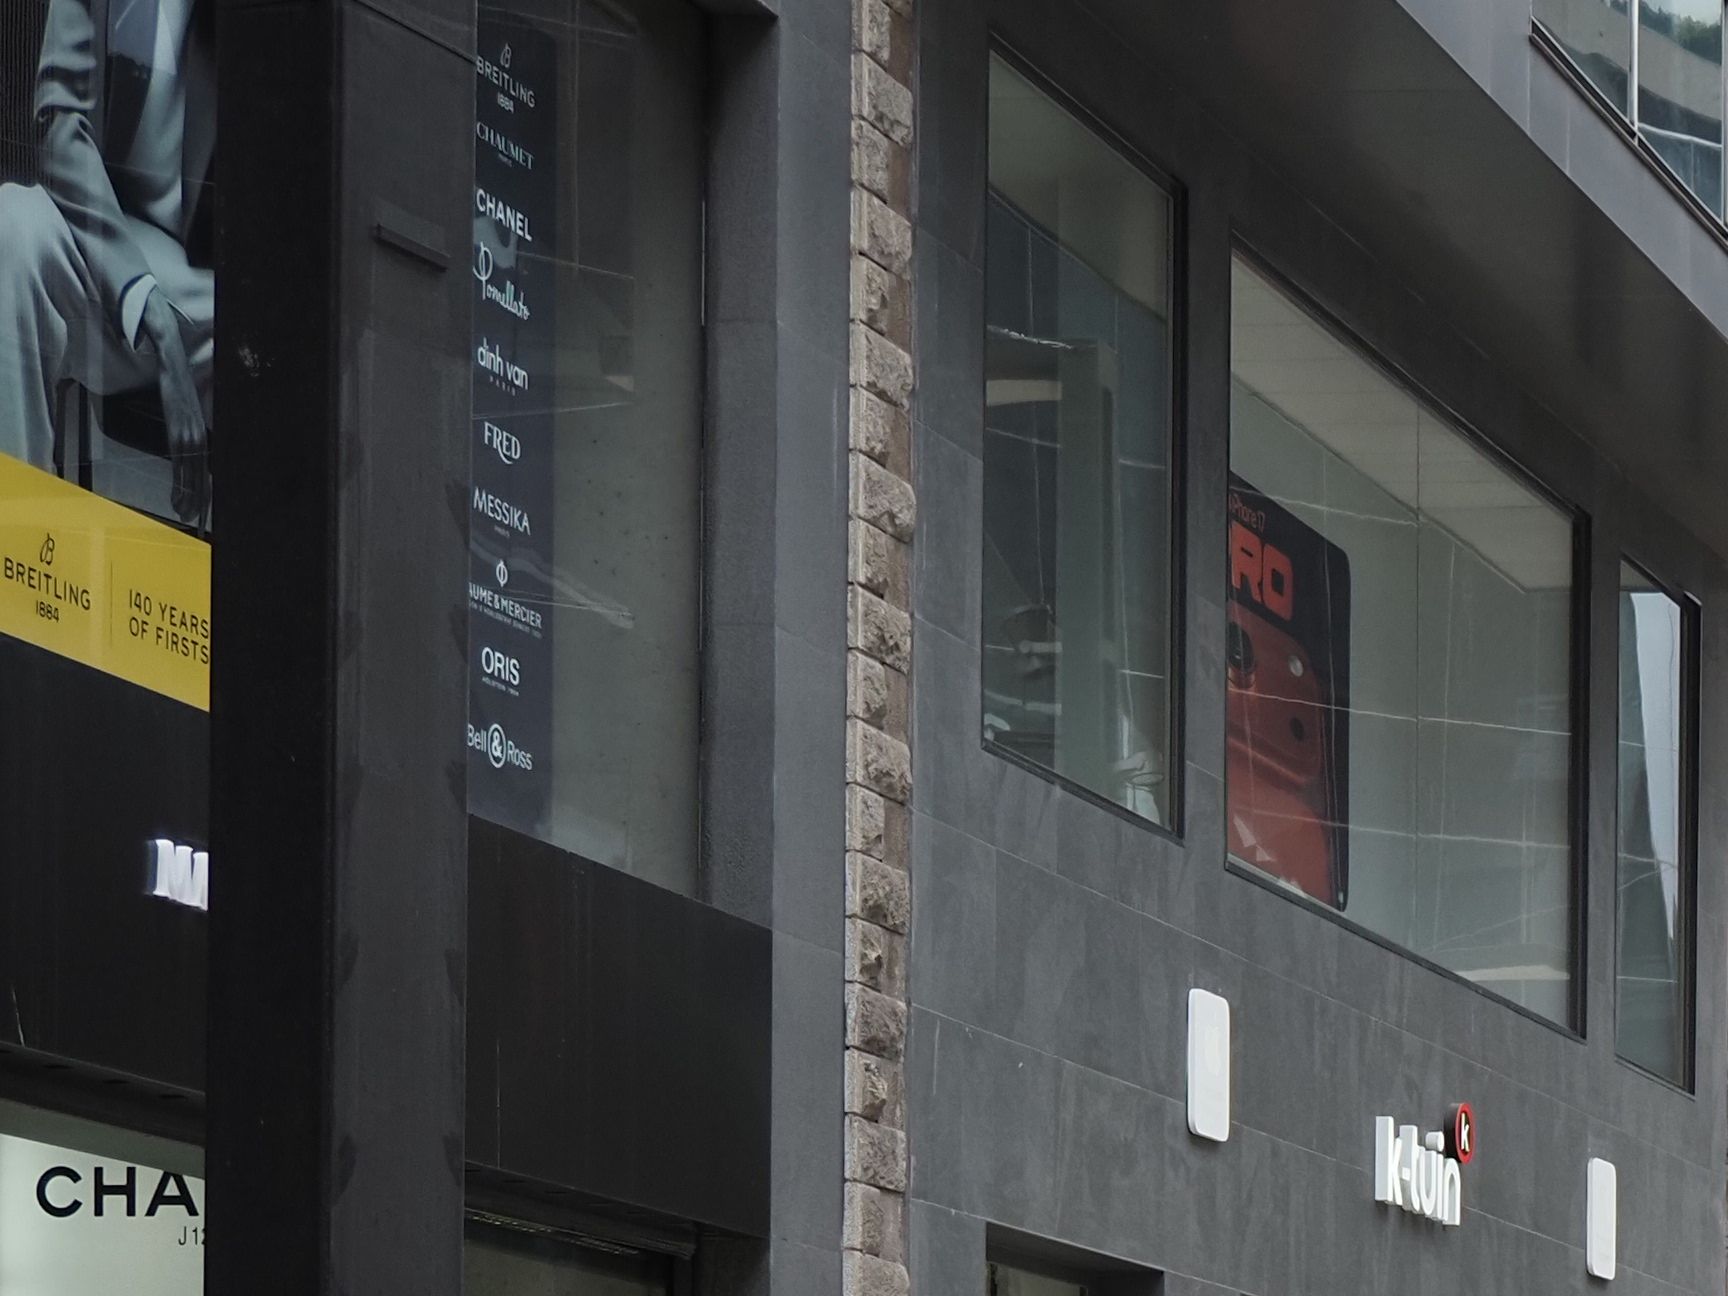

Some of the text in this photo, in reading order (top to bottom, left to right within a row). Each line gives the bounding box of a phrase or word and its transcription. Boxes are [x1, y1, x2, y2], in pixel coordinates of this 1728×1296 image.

[476, 56, 535, 108] BREITLING
[476, 121, 534, 170] CHAUMET
[476, 187, 532, 242] CHANEL
[505, 361, 529, 390] van
[484, 421, 521, 464] FRED
[473, 486, 531, 536] MESSIKA
[4, 556, 91, 611] BREITLING
[35, 600, 60, 623] 1884
[129, 589, 209, 640] 140 YEARS
[129, 616, 209, 665] OF FIRSTS
[481, 646, 520, 686] ORIS
[467, 723, 487, 752] Bell
[507, 740, 533, 770] Ross
[1375, 1114, 1461, 1226] k-tuin
